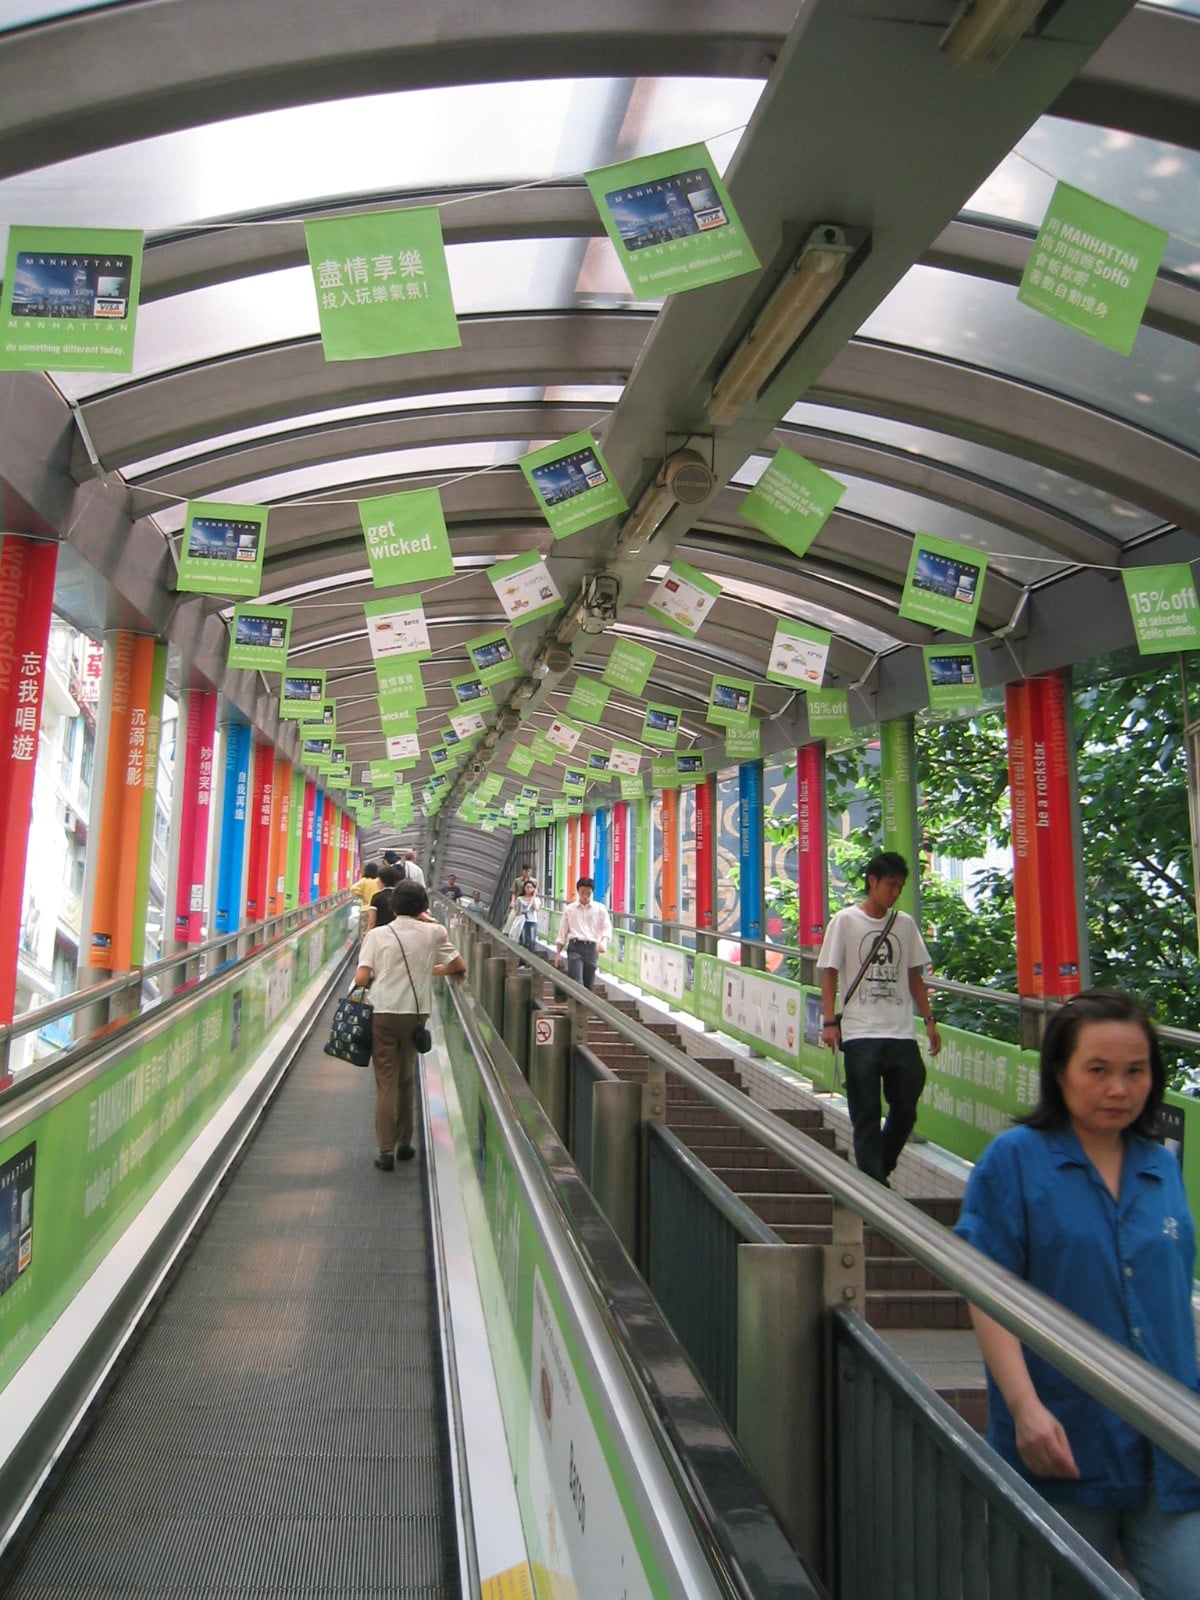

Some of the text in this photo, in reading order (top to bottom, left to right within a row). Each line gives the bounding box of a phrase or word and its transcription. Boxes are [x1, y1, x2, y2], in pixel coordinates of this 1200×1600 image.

[614, 175, 703, 203] MANHATTAN
[629, 228, 737, 263] MANHATTAN
[1060, 224, 1139, 272] MANHATTAN
[26, 259, 123, 267] MANHATTAN
[317, 250, 424, 289] 盡情享樂
[100, 303, 120, 311] VISA
[8, 321, 128, 331] MANHATTAN
[19, 343, 60, 353] something
[62, 344, 98, 354] different
[367, 520, 396, 544] get
[371, 534, 438, 560] wicked.
[1130, 588, 1196, 613] 15% off
[11, 652, 42, 761] 忘我唱遊
[126, 708, 146, 786] 沉溺光影
[1034, 741, 1049, 828] be a rockstar.
[800, 803, 808, 817] the
[801, 818, 809, 833] out
[801, 837, 809, 852] kick
